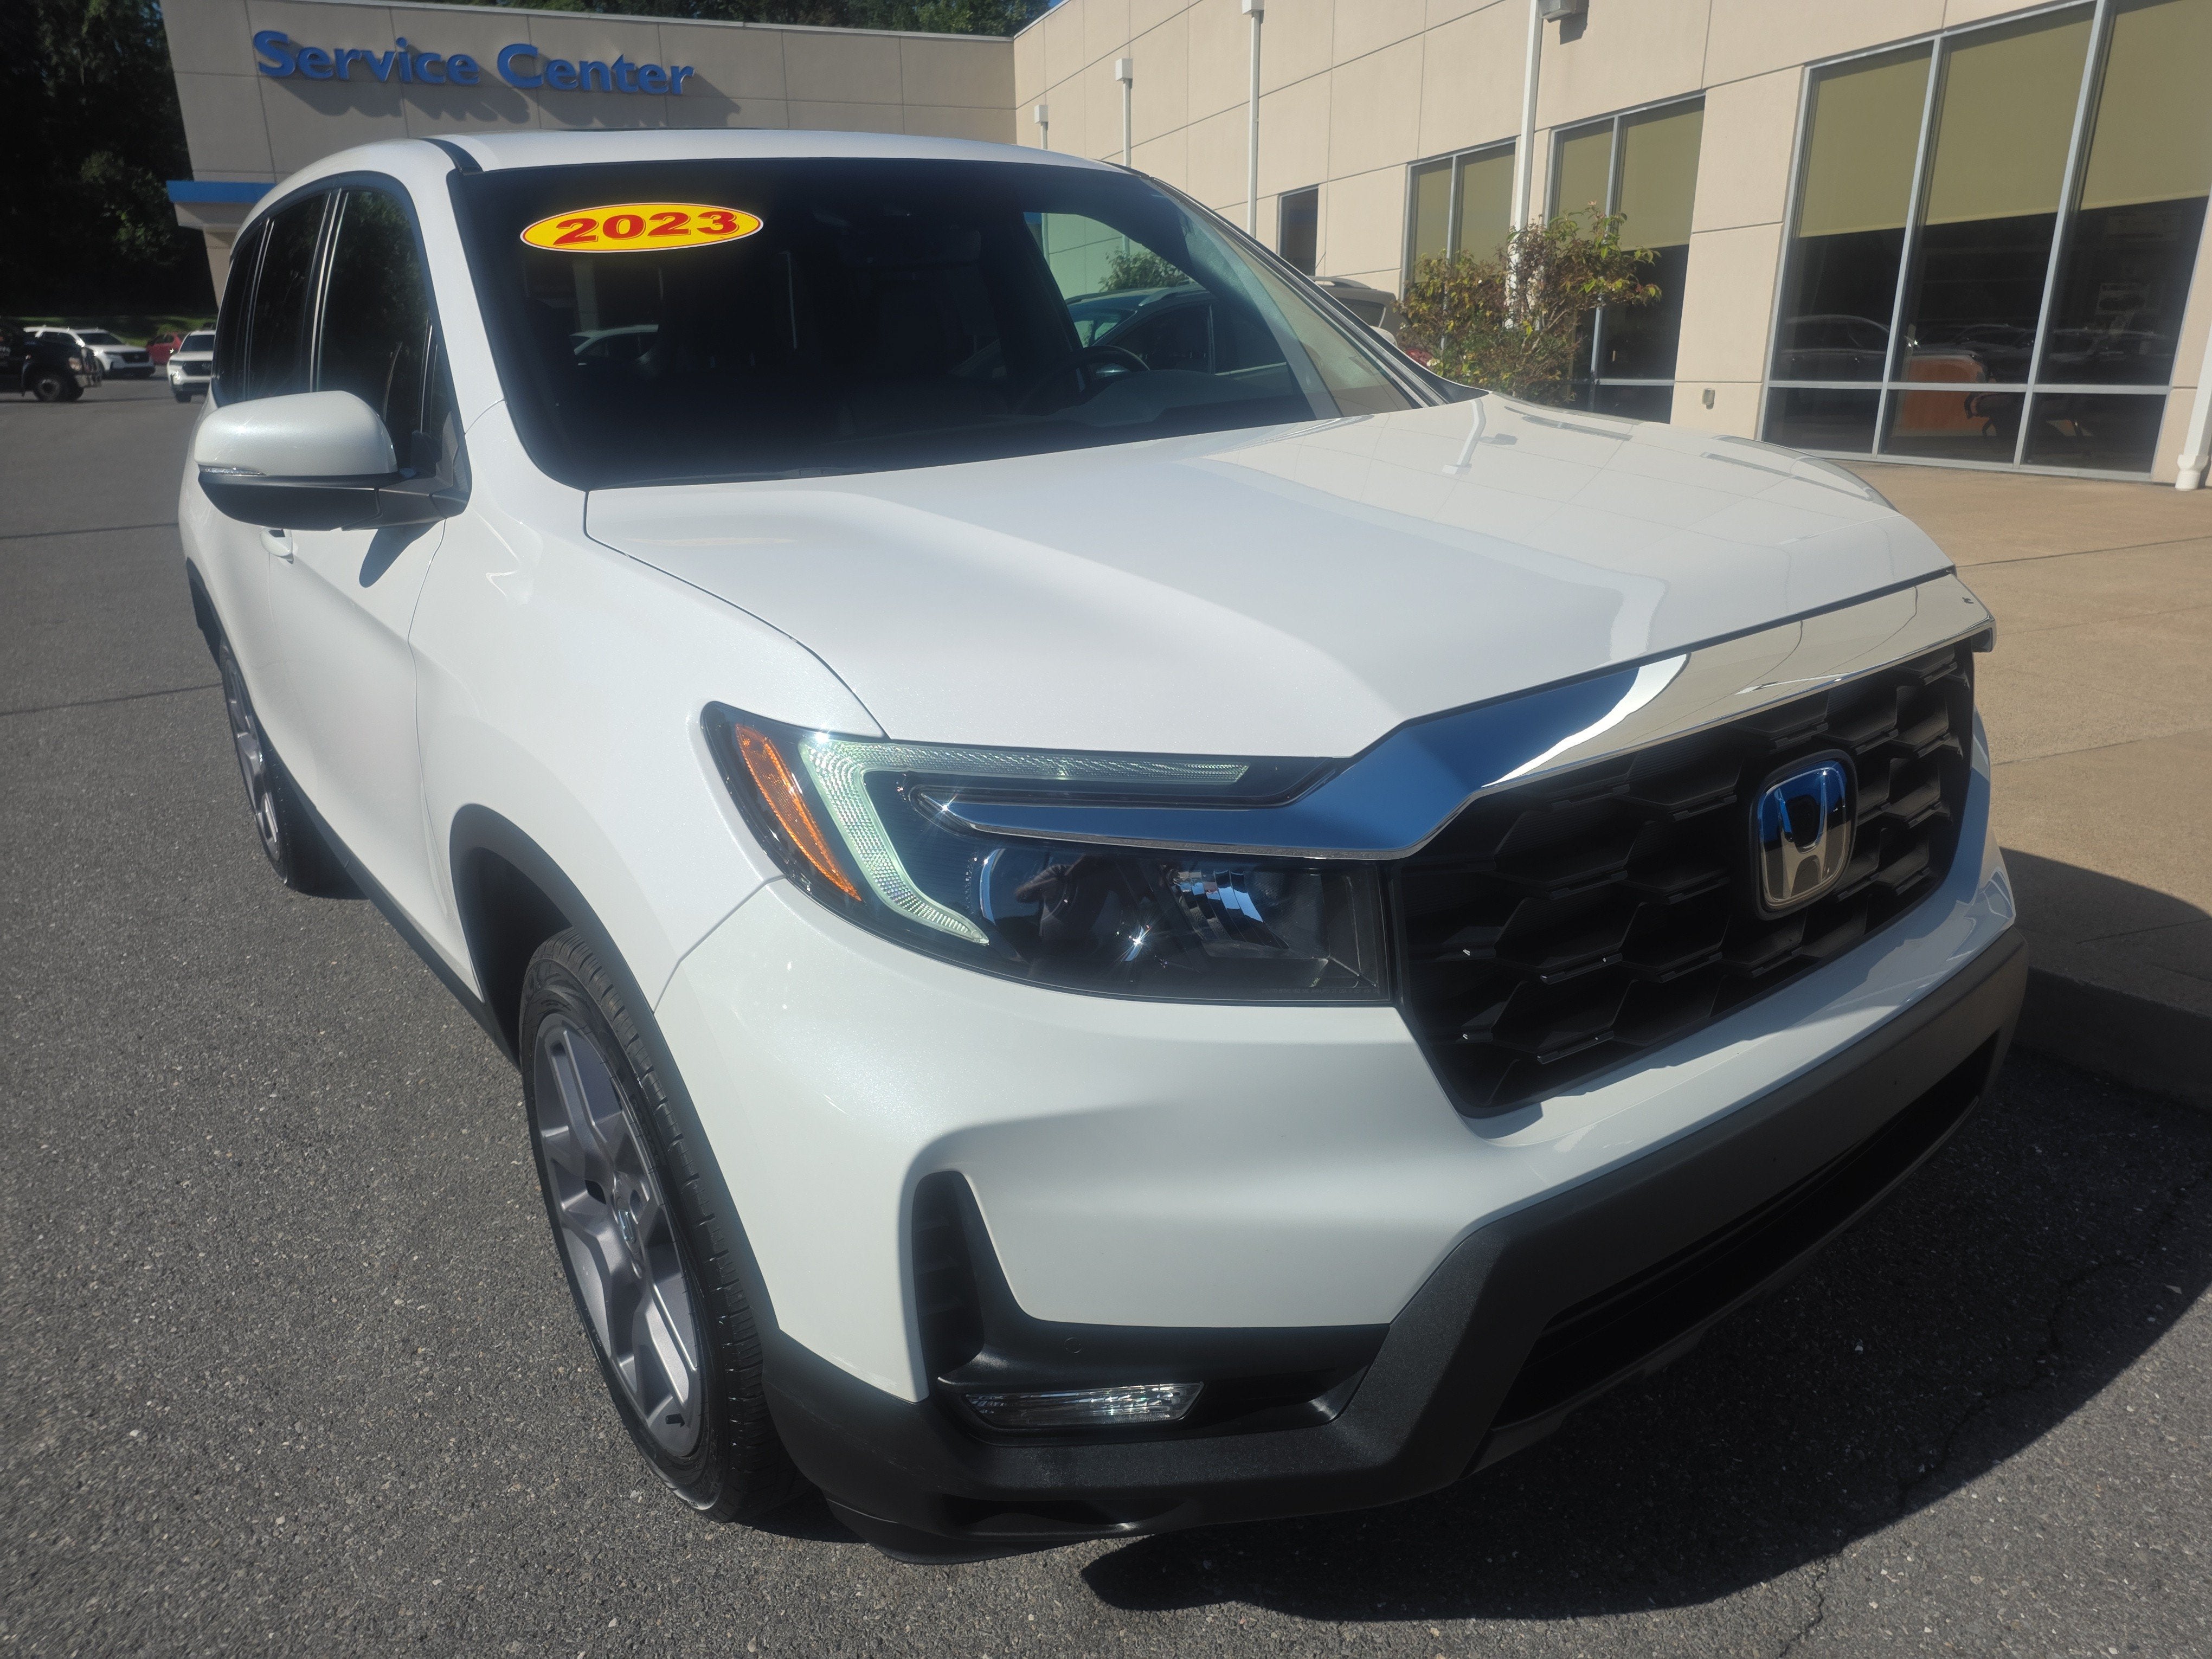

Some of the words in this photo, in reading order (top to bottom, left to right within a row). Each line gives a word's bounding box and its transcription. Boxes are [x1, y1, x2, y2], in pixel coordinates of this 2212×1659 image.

[253, 30, 480, 85] Service
[497, 43, 695, 94] Center
[553, 211, 740, 246] 2023
